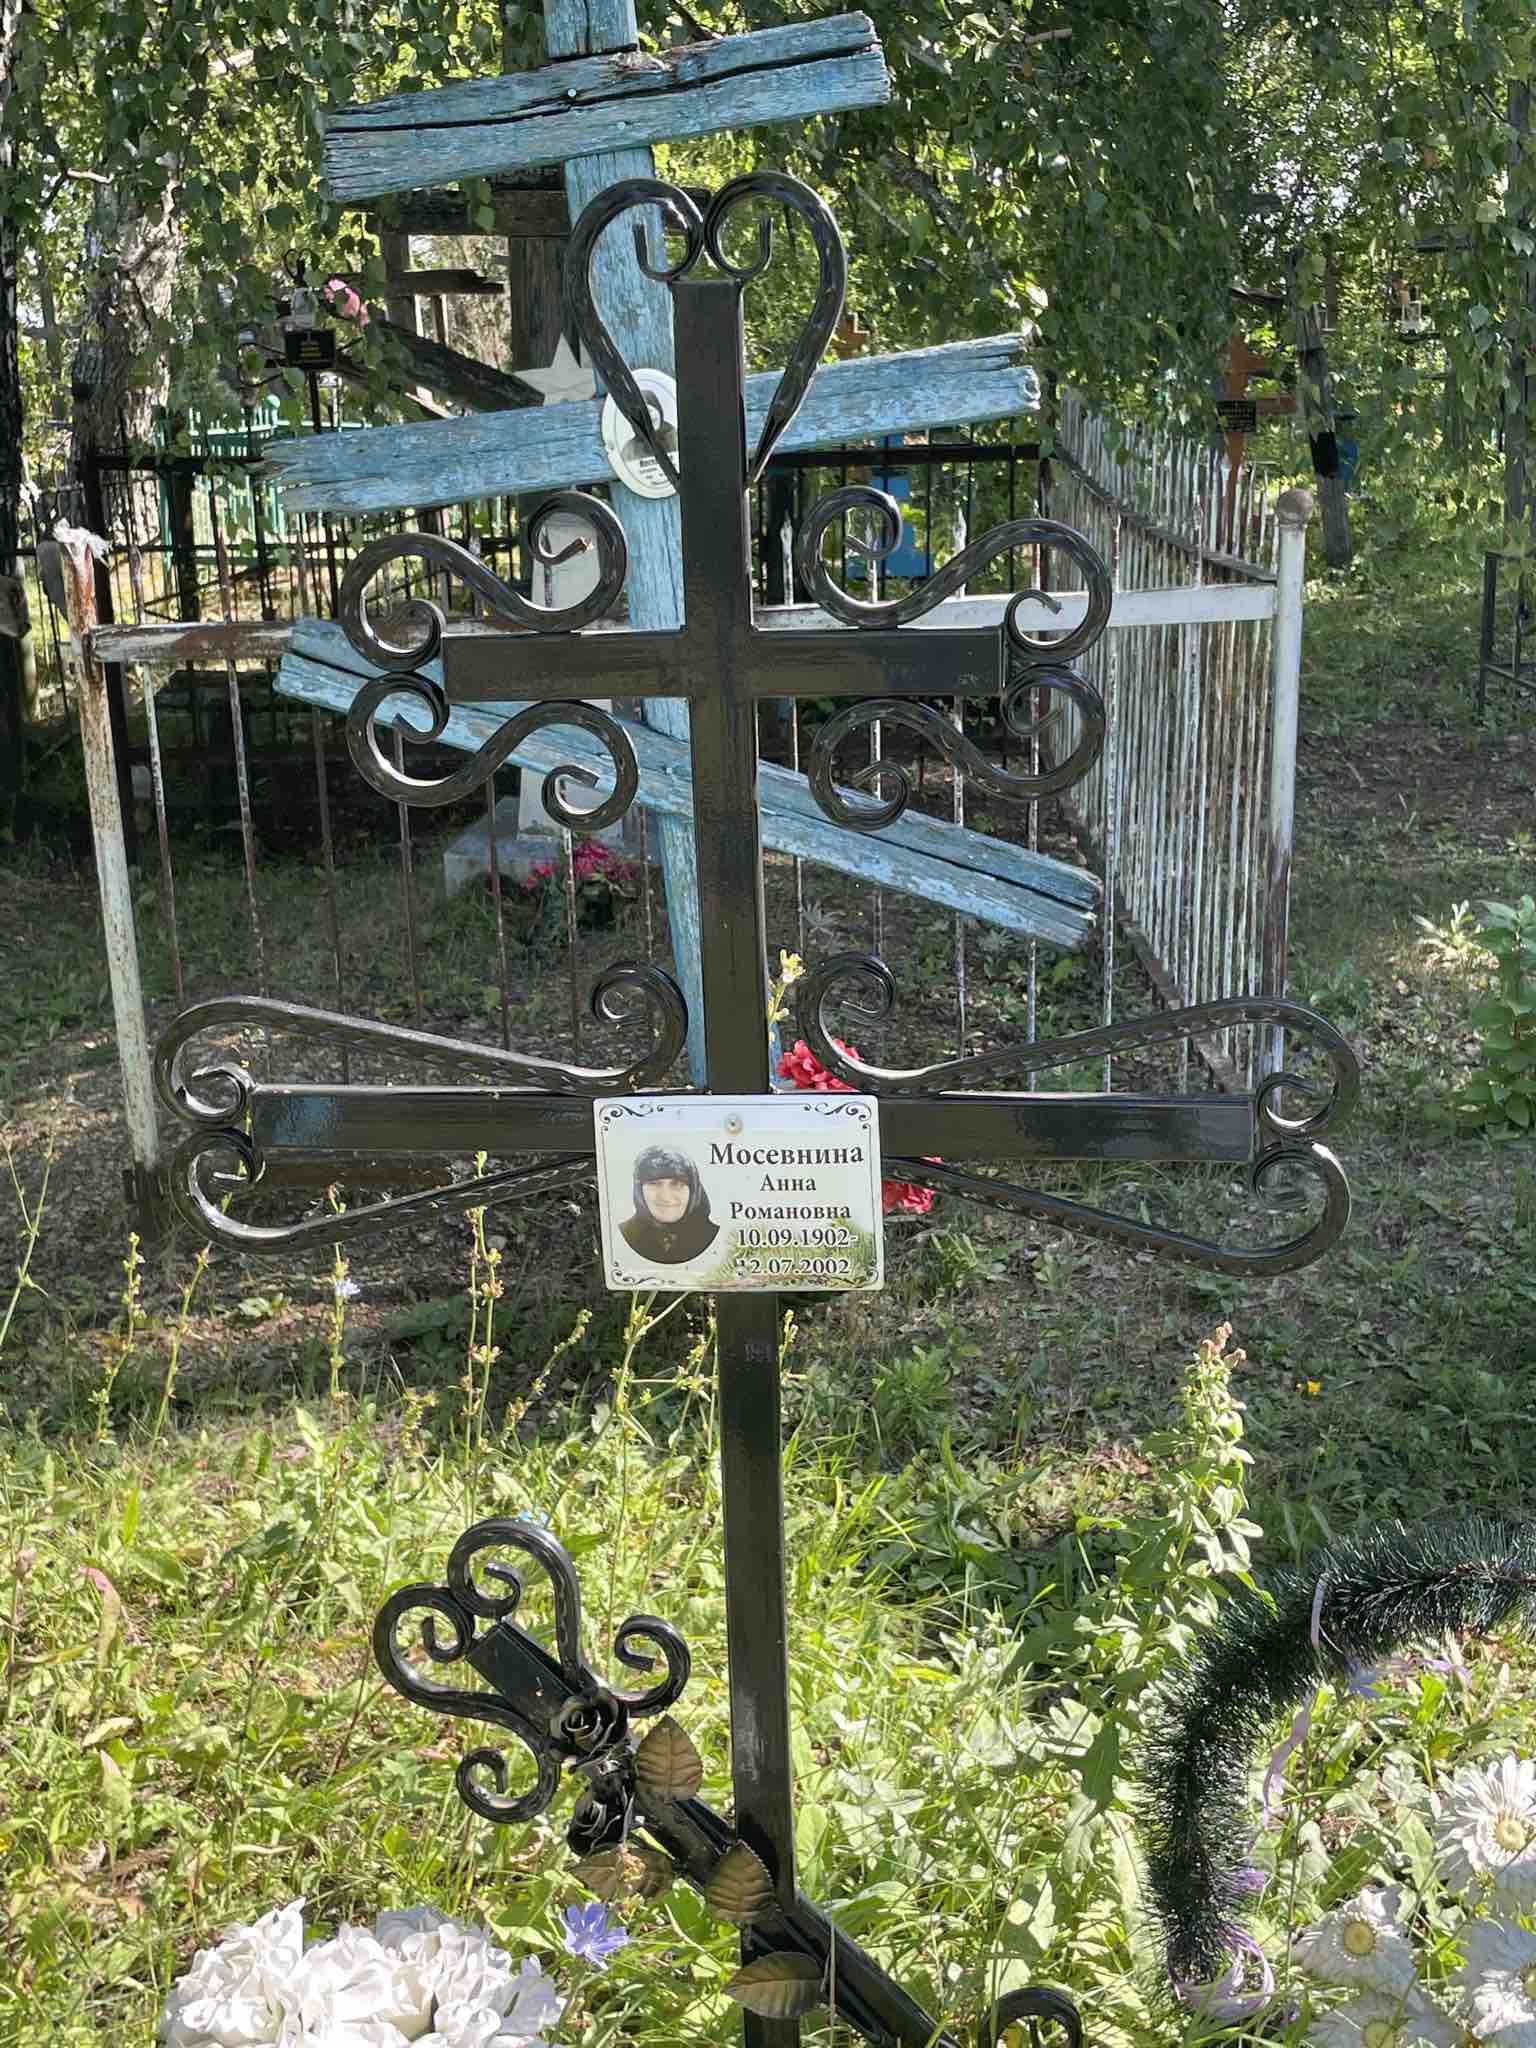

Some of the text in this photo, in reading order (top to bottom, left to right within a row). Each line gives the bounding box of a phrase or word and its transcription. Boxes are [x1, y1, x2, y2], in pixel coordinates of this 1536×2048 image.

[710, 1143, 864, 1165] Мосевнина
[760, 1173, 817, 1191] Анна
[730, 1202, 850, 1219] Романовна
